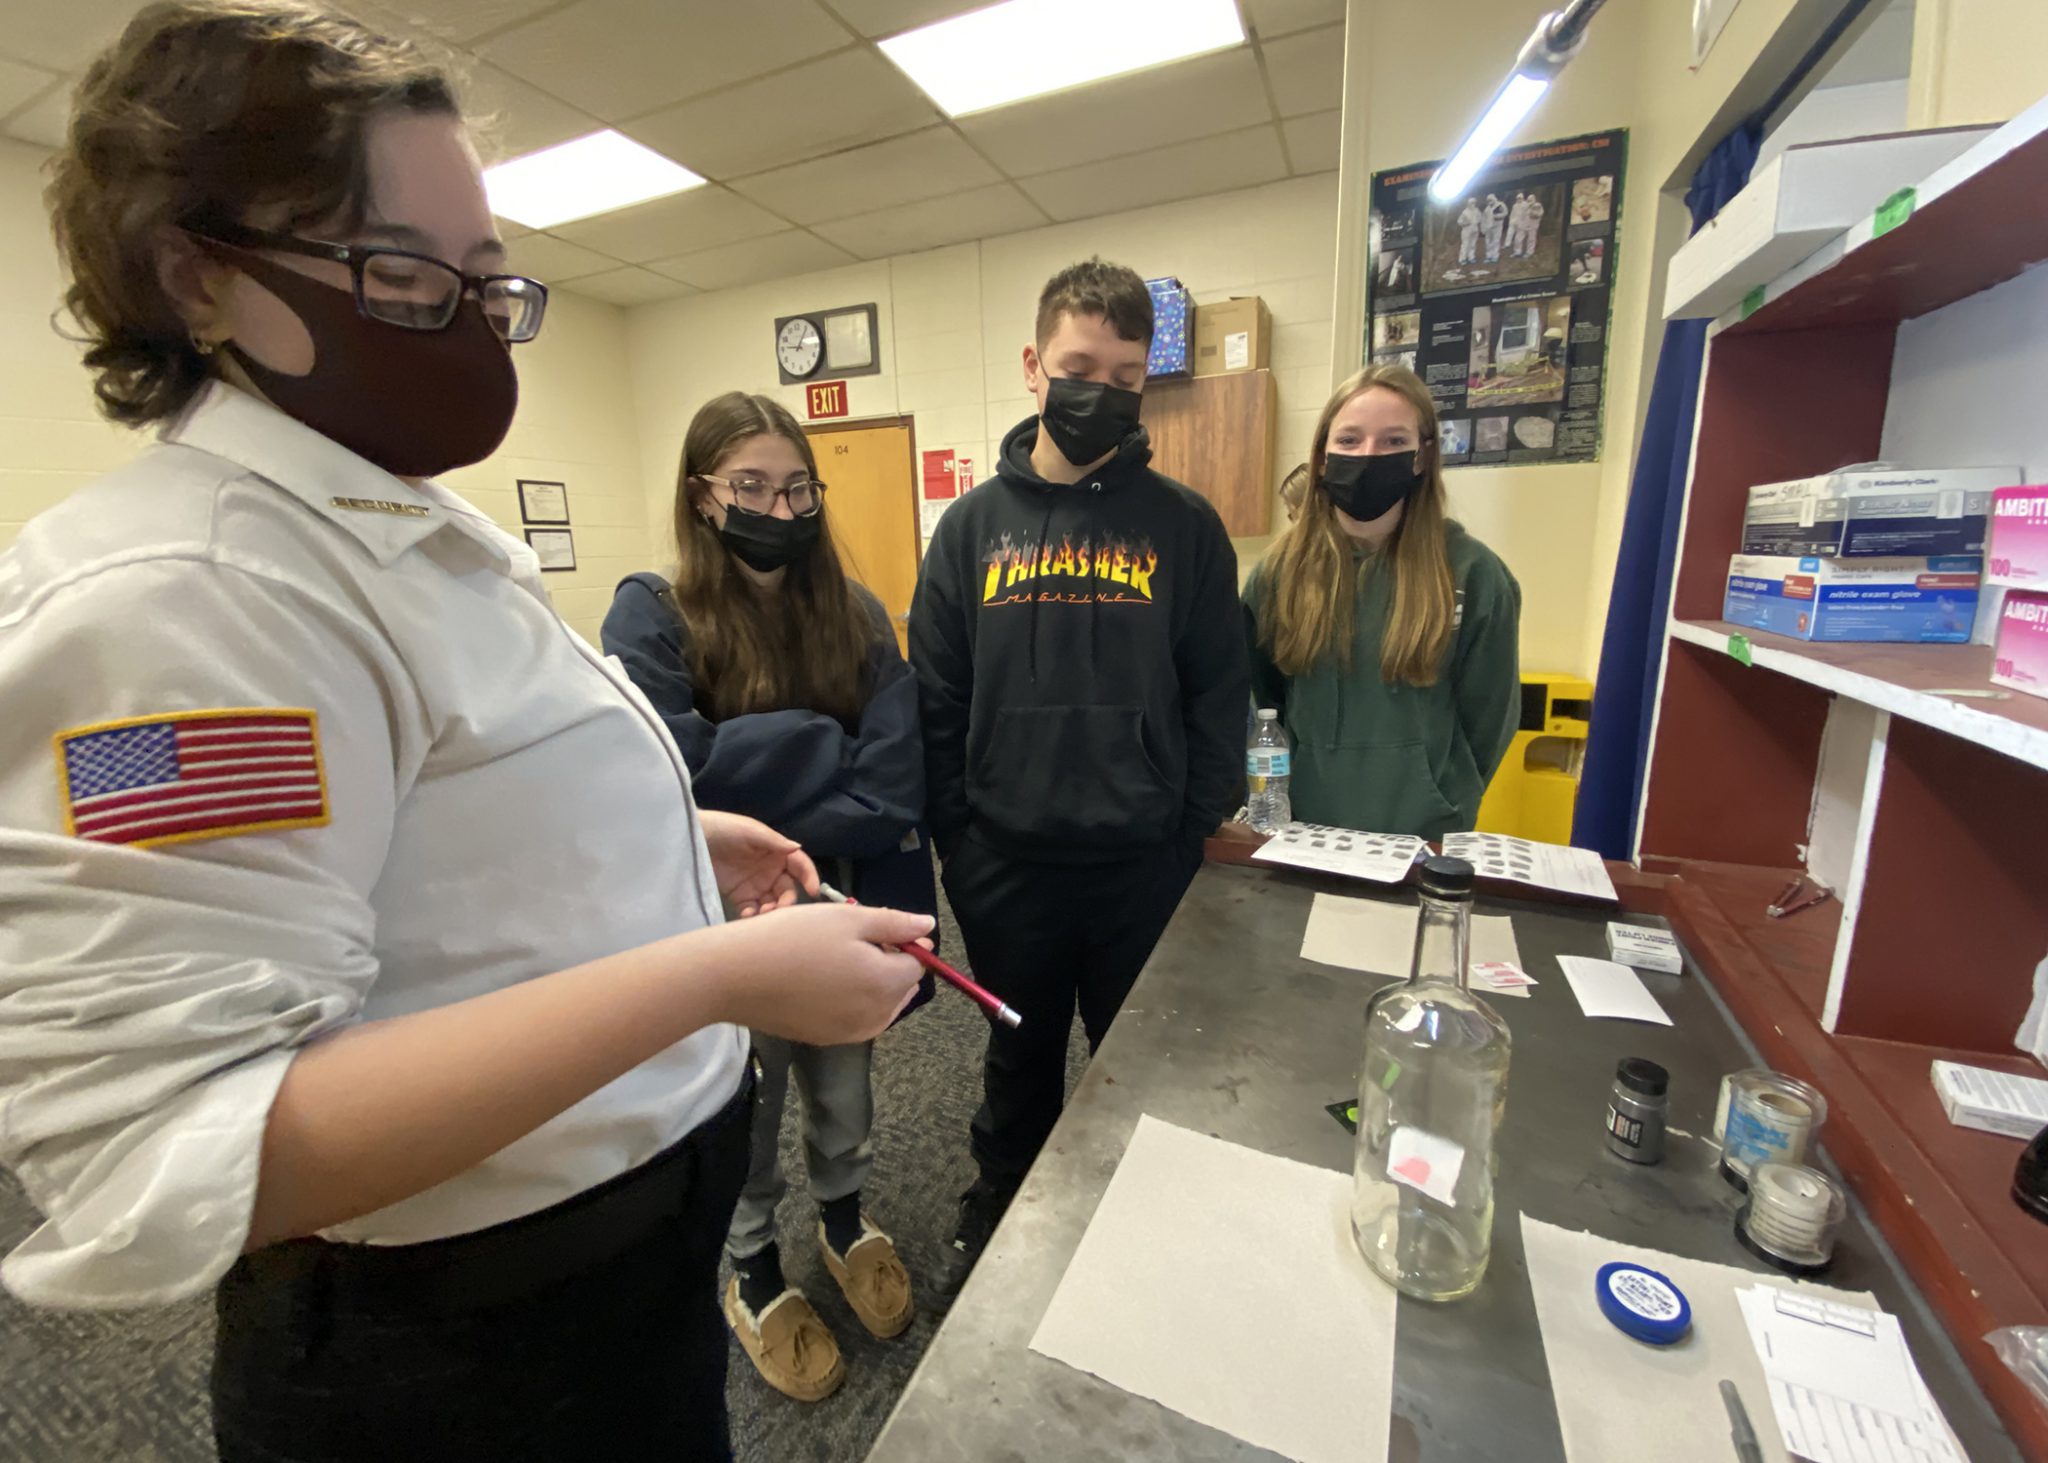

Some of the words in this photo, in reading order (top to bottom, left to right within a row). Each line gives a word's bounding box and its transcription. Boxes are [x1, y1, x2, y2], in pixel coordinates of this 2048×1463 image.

[811, 385, 840, 416] EXIT
[833, 444, 849, 456] 104
[982, 540, 1158, 604] THRASHER
[1006, 592, 1126, 604] MAGAZINE
[1828, 590, 1860, 599] nitrile
